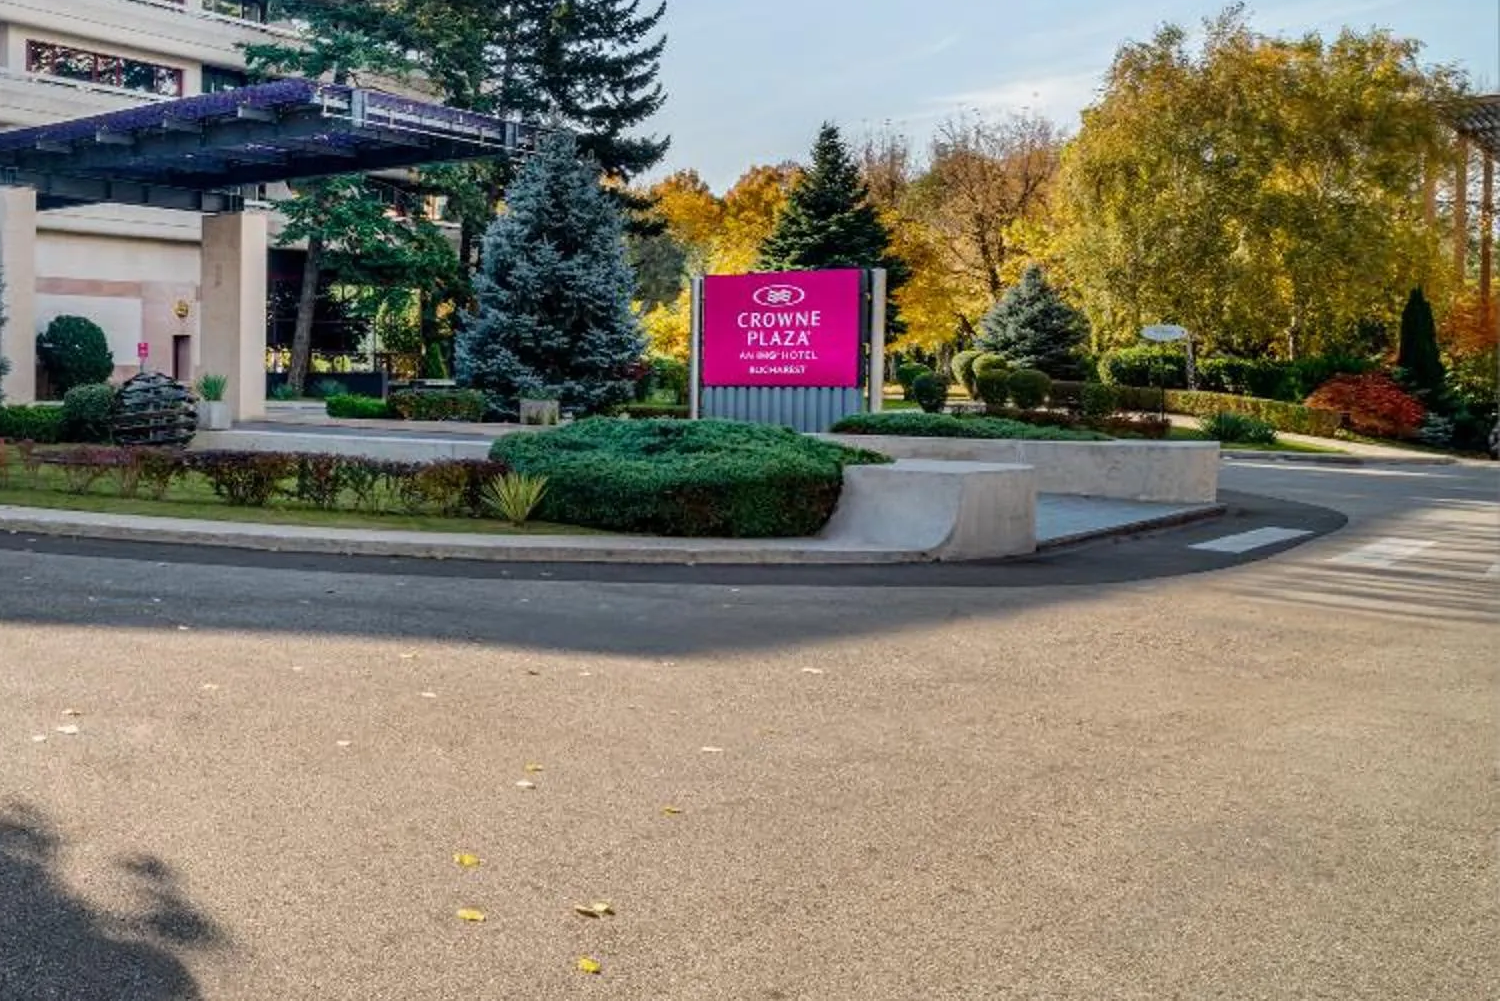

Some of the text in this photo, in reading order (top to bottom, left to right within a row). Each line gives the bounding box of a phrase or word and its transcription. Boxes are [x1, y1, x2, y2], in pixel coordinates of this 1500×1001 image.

[737, 310, 821, 328] CROWNE
[747, 330, 811, 347] PLAZA
[739, 350, 755, 360] AN
[781, 350, 819, 360] HOTEL
